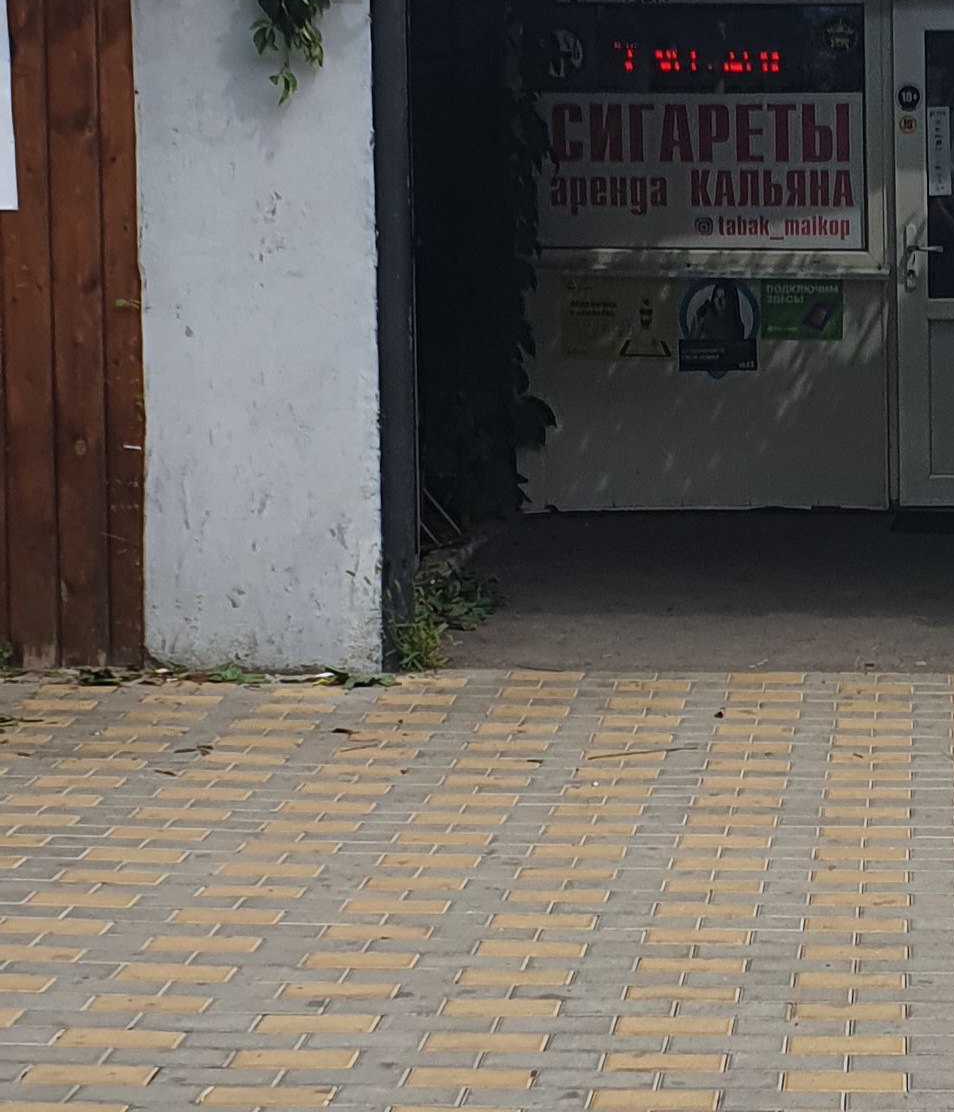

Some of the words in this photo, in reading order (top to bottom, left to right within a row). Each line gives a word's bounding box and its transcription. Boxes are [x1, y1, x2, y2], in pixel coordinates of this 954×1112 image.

[550, 102, 851, 163] СИГАРЕТЫ
[550, 176, 669, 216] аренда
[690, 168, 855, 208] КАЛЬЯНА
[766, 284, 839, 294] ПОДКЛЮЧИМ
